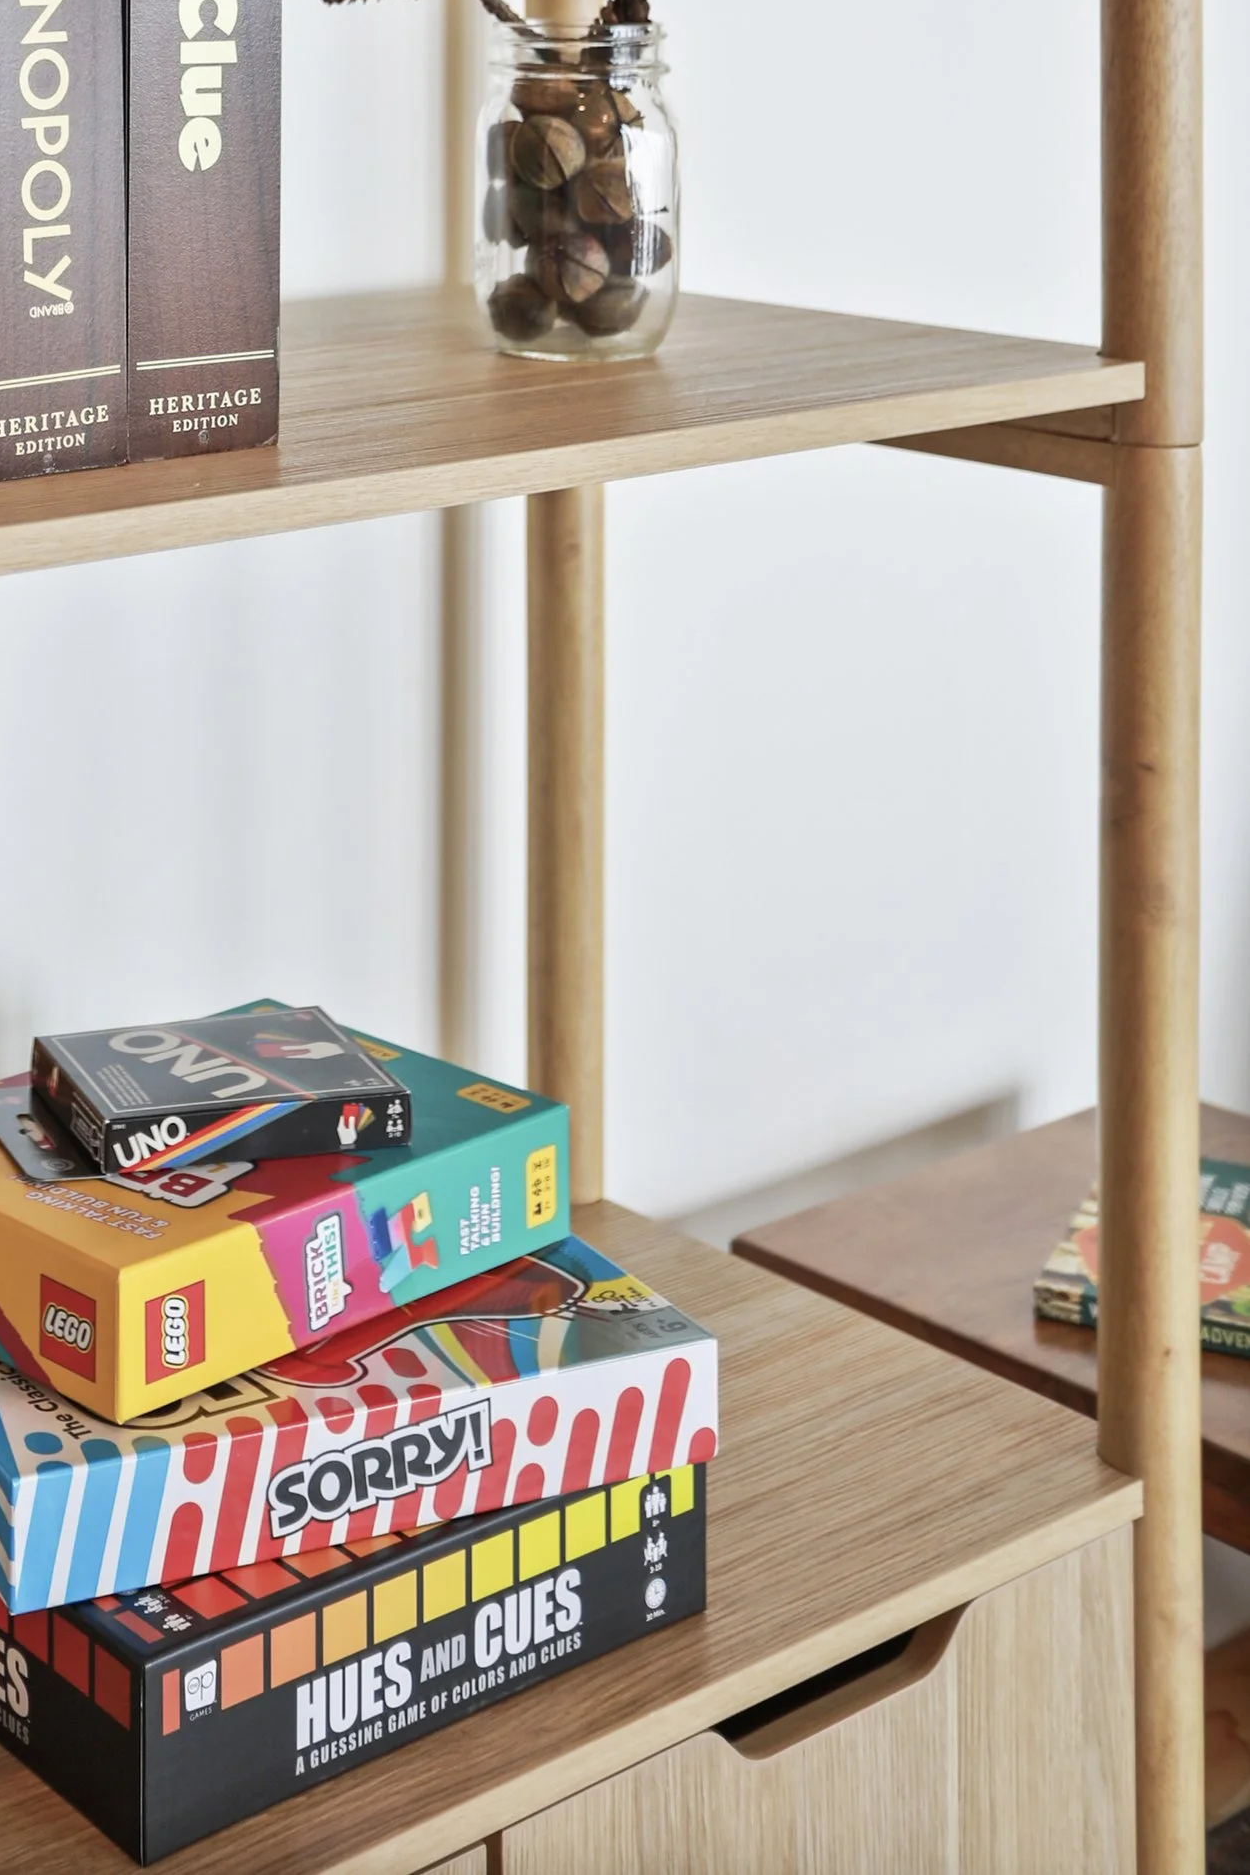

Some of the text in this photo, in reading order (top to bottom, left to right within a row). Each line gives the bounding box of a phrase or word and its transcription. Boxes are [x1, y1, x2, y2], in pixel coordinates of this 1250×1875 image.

[149, 387, 262, 416] HERITAGE
[172, 413, 239, 433] EDITION
[14, 431, 87, 457] EDITION
[108, 1029, 268, 1099] UNO
[112, 1115, 188, 1169] UNO
[25, 1190, 162, 1240] FAST TALKING
[106, 1205, 153, 1224] FUN
[460, 1218, 470, 1255] FAST
[470, 1186, 480, 1251] TALKING
[481, 1203, 491, 1234] FUN
[323, 1223, 338, 1282] THIS!
[310, 1241, 328, 1321] BRICK
[43, 1304, 93, 1352] LEGO
[162, 1296, 188, 1367] LEGO
[0, 1366, 91, 1439] The Classic
[270, 1408, 487, 1523] SORRY!
[297, 1568, 582, 1751] HUES AND CUES
[189, 1705, 213, 1721] GAMES
[295, 1631, 582, 1776] A GUESSING GAME OF COLORS AND CLUES
